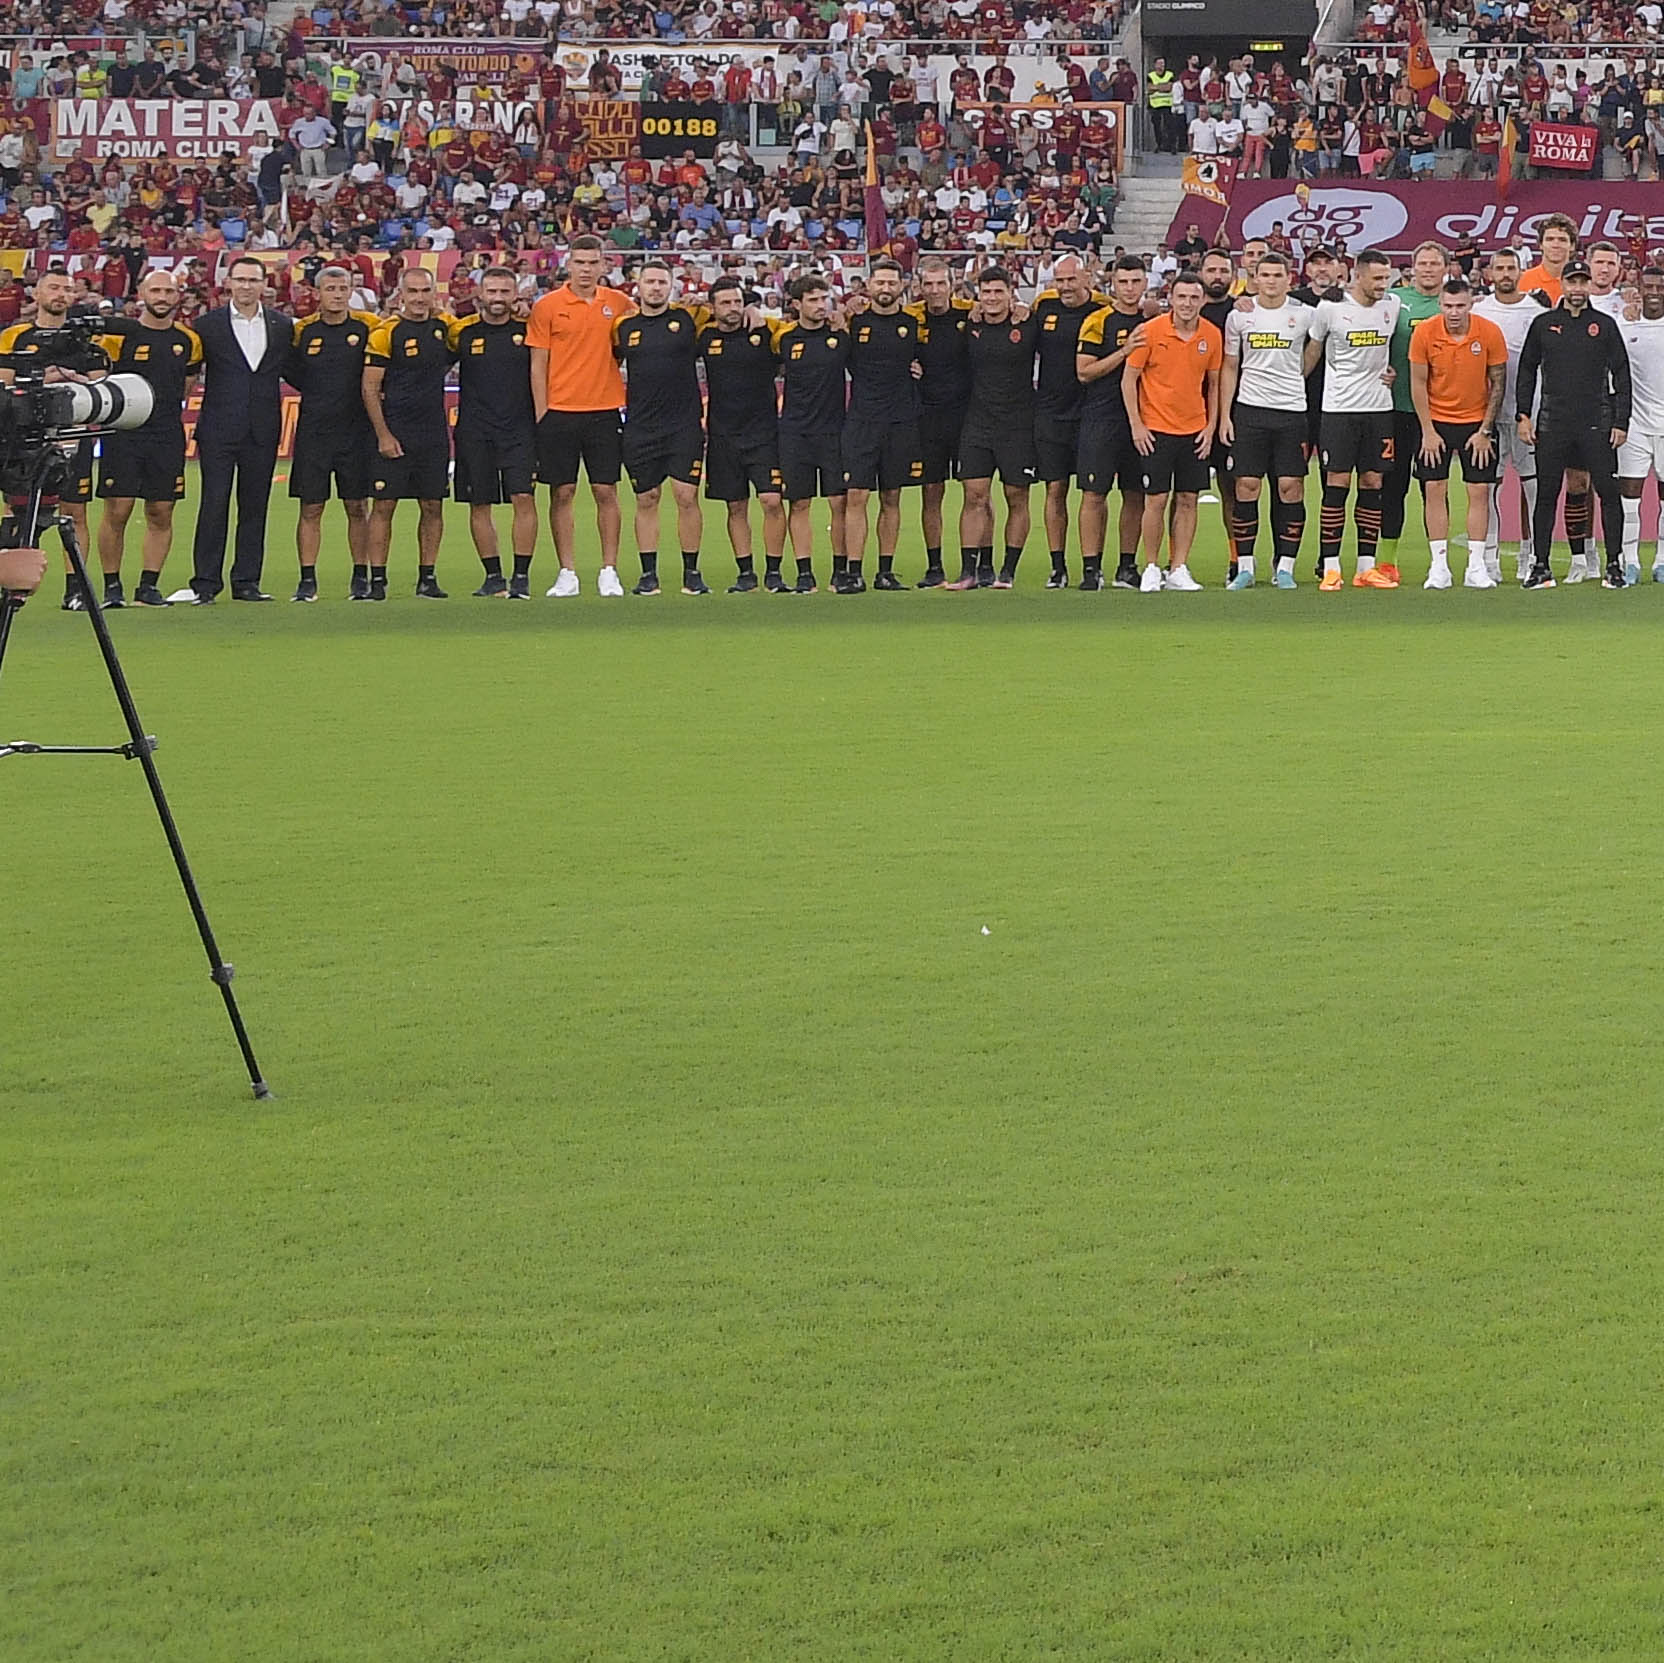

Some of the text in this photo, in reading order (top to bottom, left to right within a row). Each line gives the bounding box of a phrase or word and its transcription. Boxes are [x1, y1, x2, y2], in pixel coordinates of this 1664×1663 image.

[413, 46, 449, 54] ROMA
[57, 98, 280, 137] MATERA
[642, 117, 717, 136] 00188
[1535, 130, 1578, 147] VIVA
[97, 140, 240, 158] ROMA CLUB
[1533, 145, 1589, 162] ROMA
